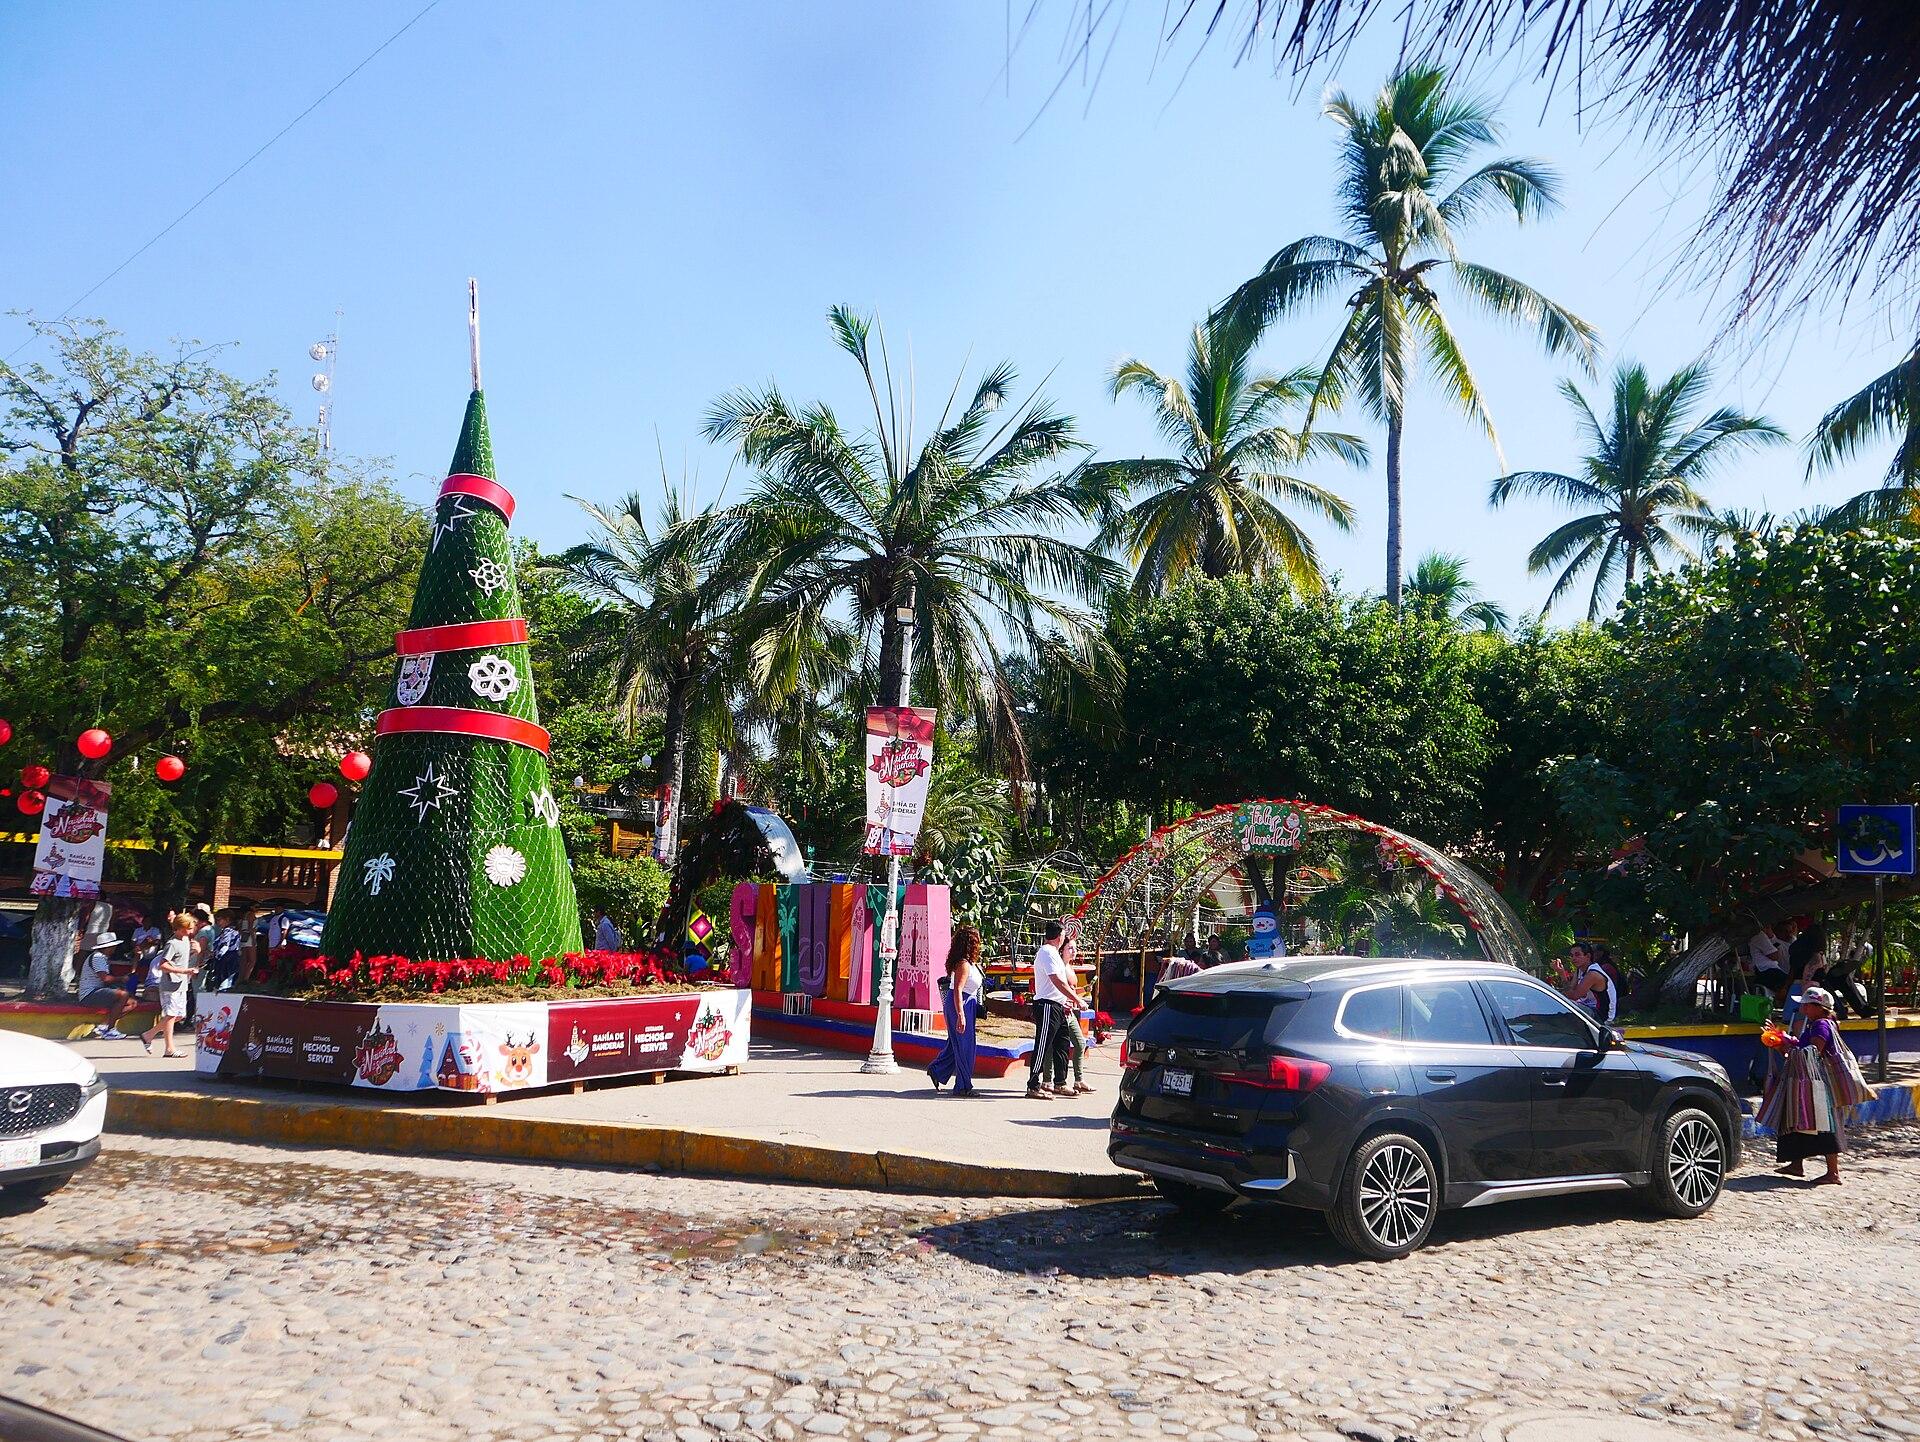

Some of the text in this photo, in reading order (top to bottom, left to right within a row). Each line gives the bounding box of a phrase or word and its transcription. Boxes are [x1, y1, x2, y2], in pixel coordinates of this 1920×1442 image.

[52, 811, 98, 835] Navidad
[1247, 805, 1281, 832] Feliz
[1239, 823, 1300, 847] Navidad
[266, 1035, 294, 1045] BAHÍA DE
[593, 1031, 624, 1042] BAHÍA DE
[634, 1032, 664, 1043] HECHOS
[265, 1045, 293, 1054] BANDERAS
[302, 1042, 331, 1053] HECHOS
[592, 1041, 624, 1052] BANDERAS
[640, 1042, 668, 1053] SERVIR
[307, 1053, 334, 1064] SERVIR
